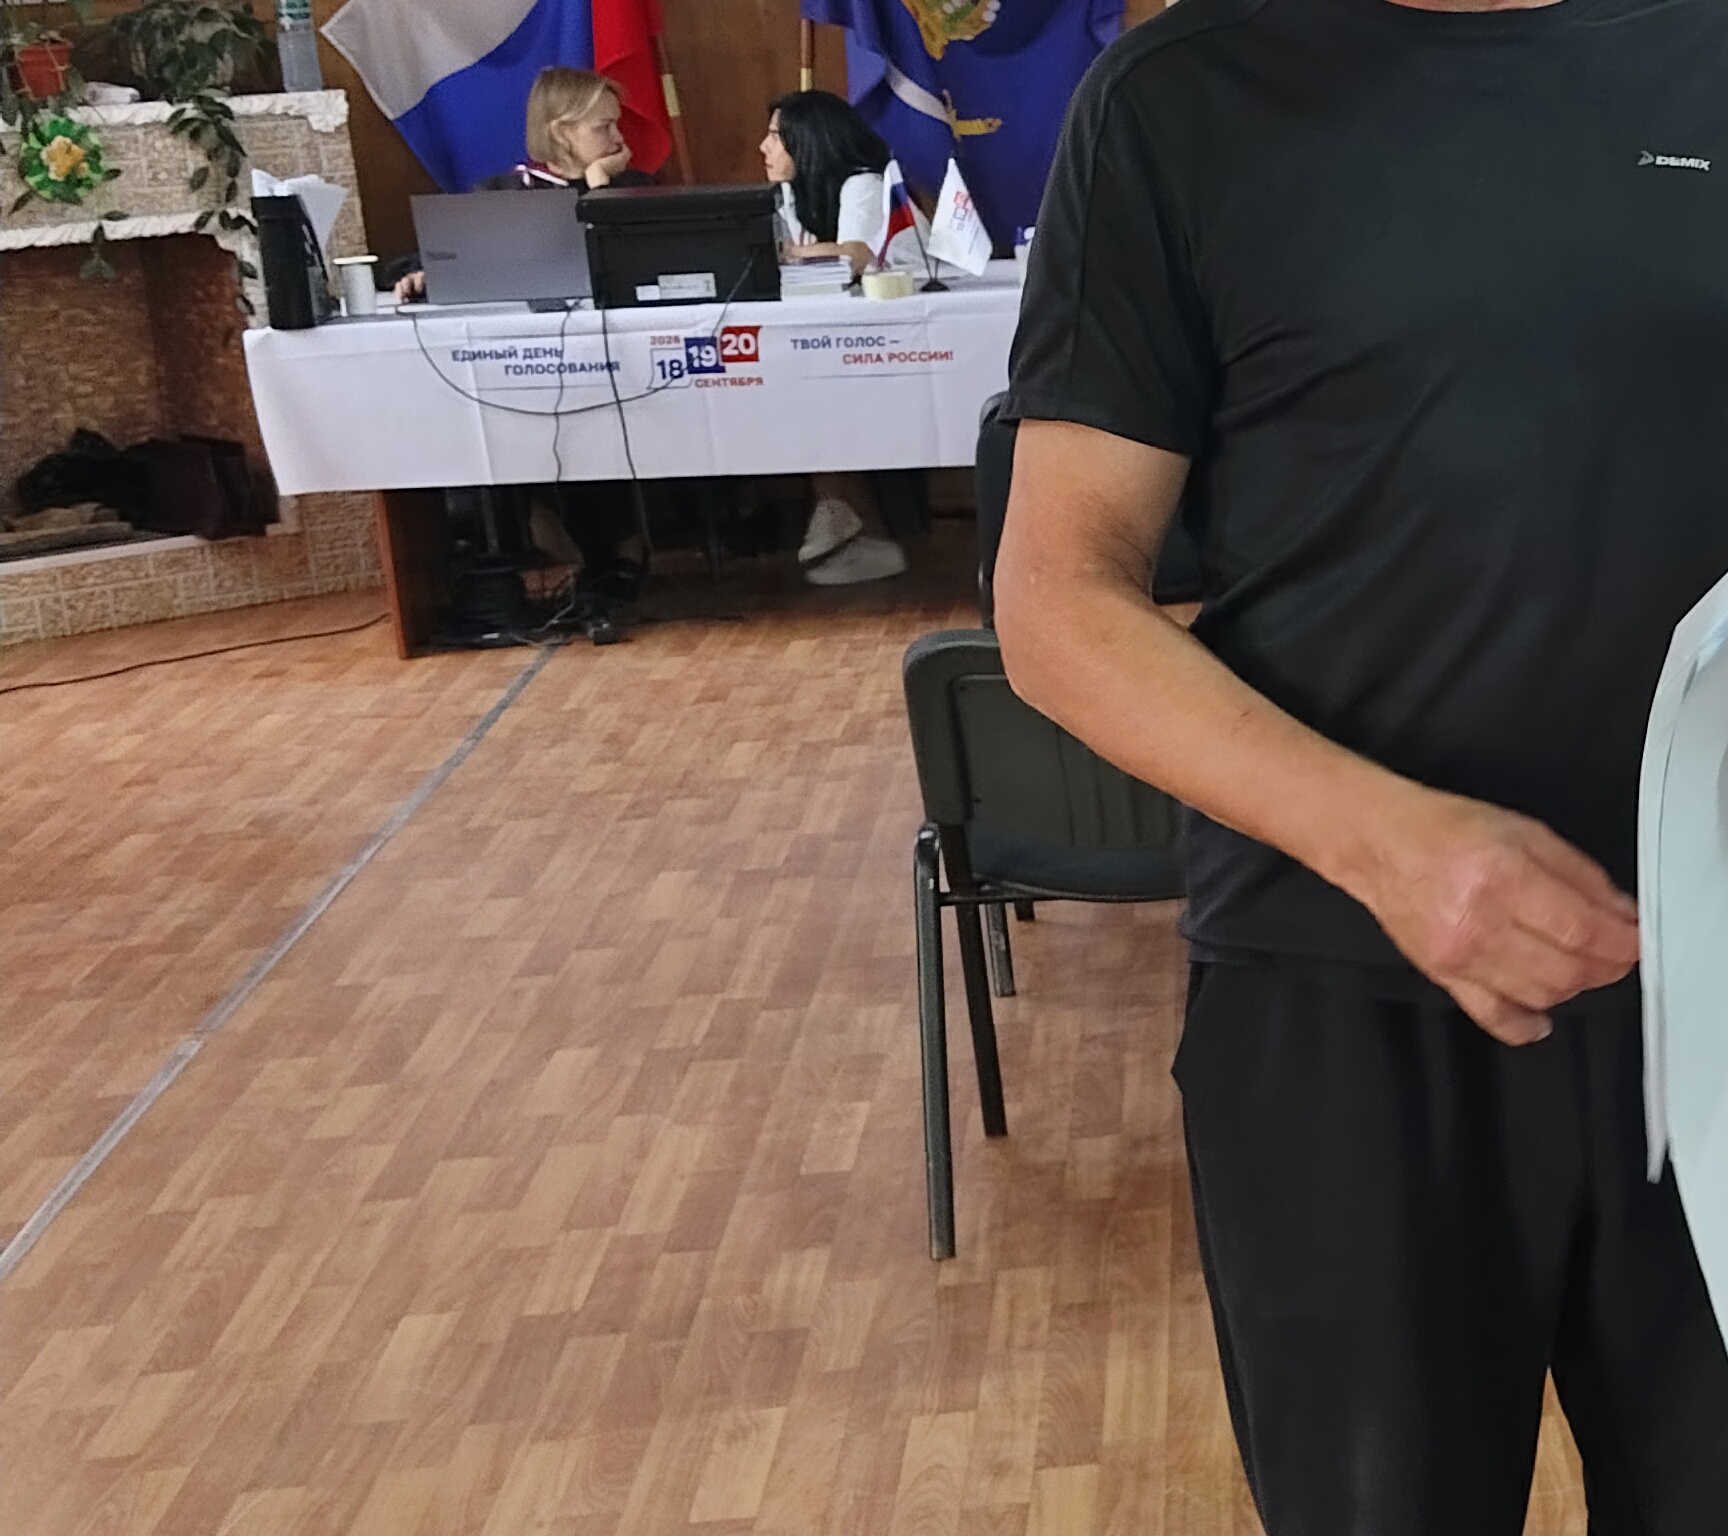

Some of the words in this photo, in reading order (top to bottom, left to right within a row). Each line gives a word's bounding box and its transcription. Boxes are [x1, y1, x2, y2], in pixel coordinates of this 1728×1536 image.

[1655, 155, 1711, 171] DEMIX
[790, 335, 832, 350] ТВОЙ
[835, 335, 886, 349] ГОЛОС
[451, 345, 519, 362] ЕДИНЫЙ
[522, 347, 564, 360] ДЕНЬ
[656, 358, 685, 380] 18
[687, 344, 718, 369] 19
[721, 332, 757, 356] 20
[842, 352, 885, 365] СИЛА
[887, 350, 954, 364] РОССИИ!
[504, 361, 621, 376] ГОЛОСОВАНИЯ
[694, 376, 764, 389] СЕНТЯБРЯ
